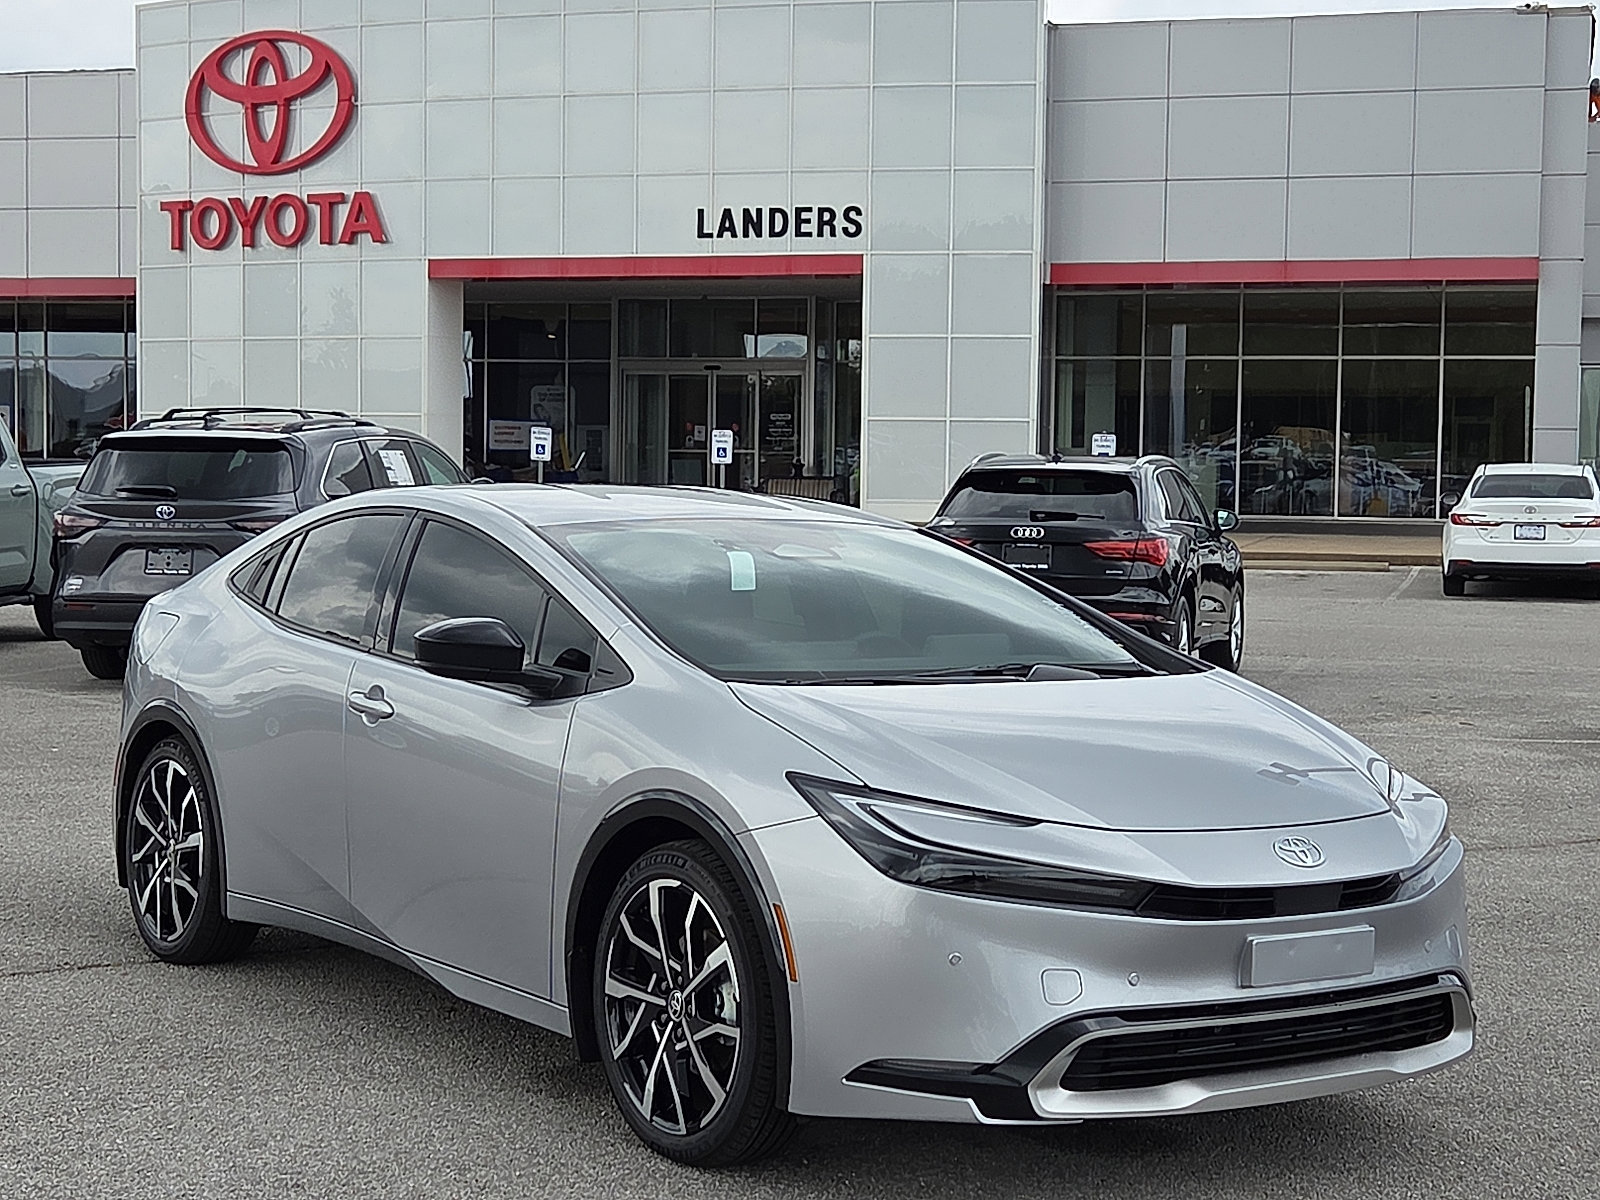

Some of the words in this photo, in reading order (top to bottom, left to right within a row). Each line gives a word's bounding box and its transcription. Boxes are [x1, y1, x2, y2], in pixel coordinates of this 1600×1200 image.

[160, 191, 386, 250] TOYOTA
[697, 206, 863, 238] LANDERS
[640, 854, 684, 869] MICHELIN
